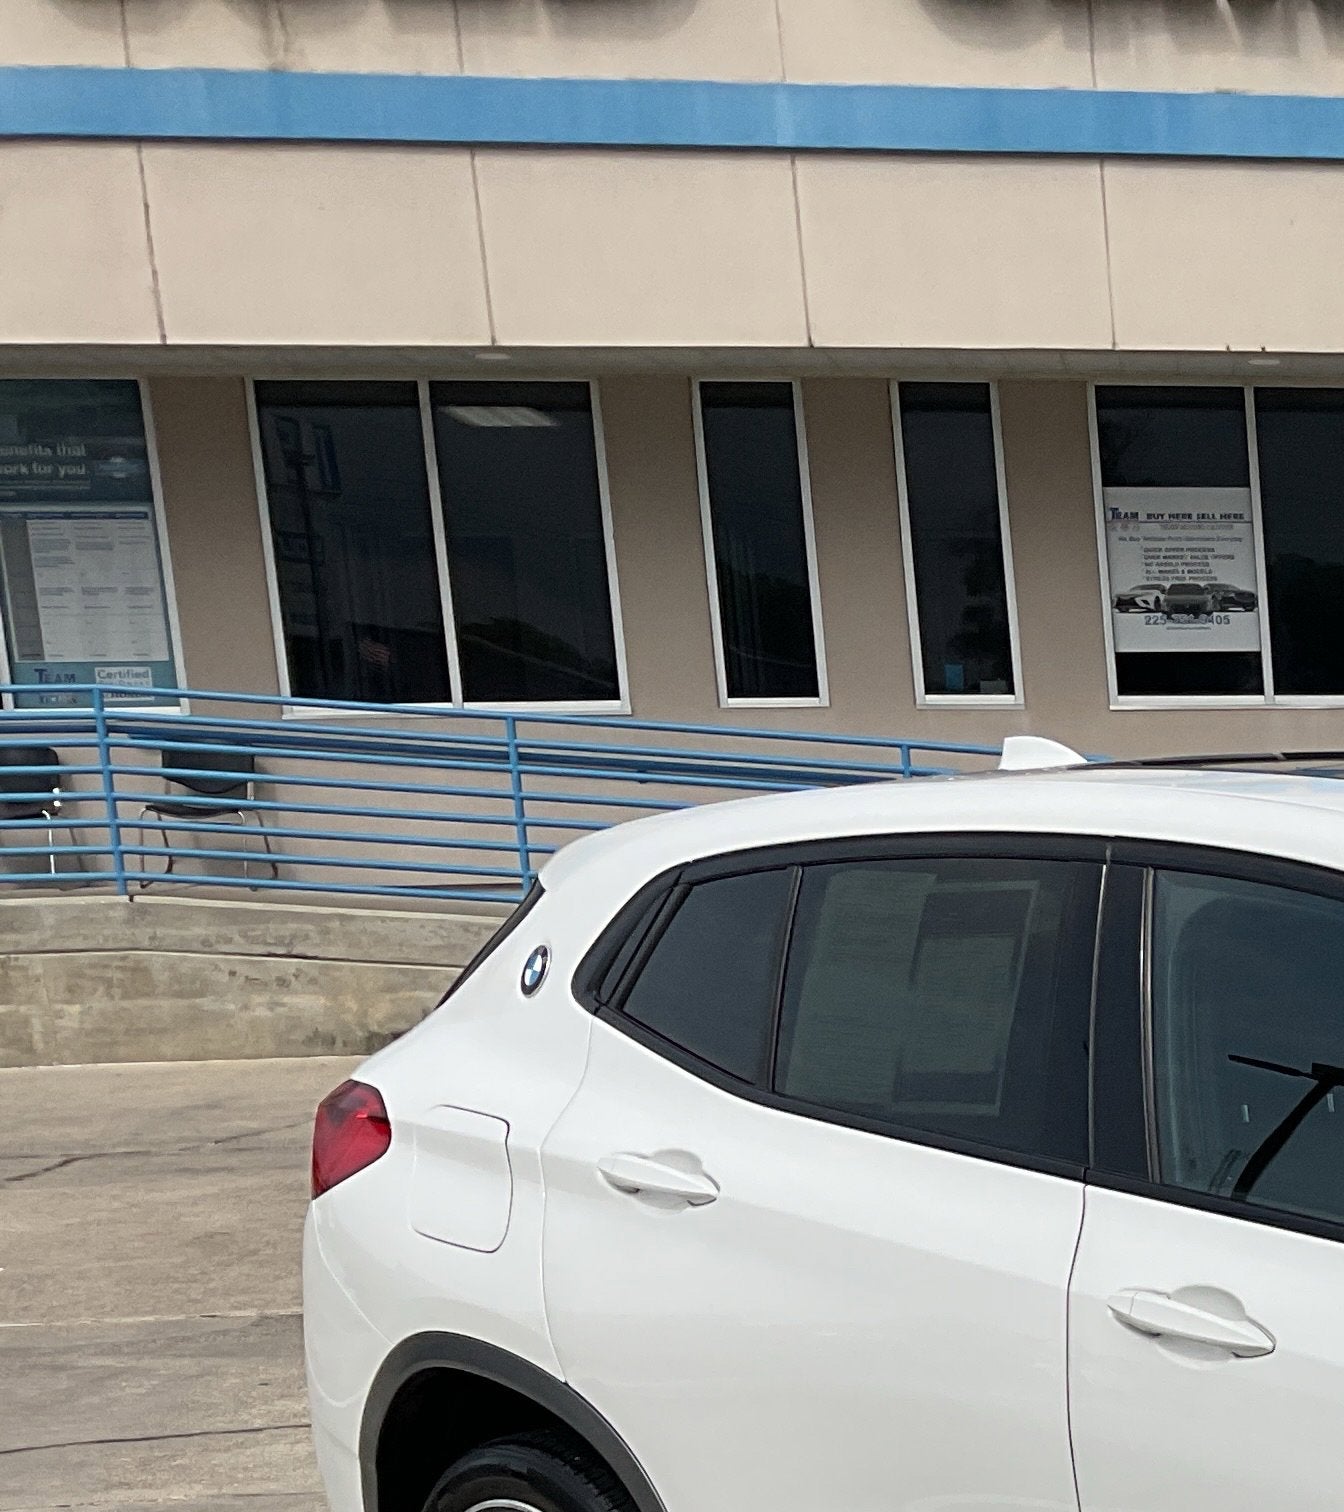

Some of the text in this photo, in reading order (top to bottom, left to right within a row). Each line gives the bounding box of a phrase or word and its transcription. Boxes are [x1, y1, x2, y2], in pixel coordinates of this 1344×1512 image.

[56, 442, 86, 456] that
[0, 460, 85, 478] ork for you
[34, 668, 76, 683] TEAM
[97, 669, 149, 682] Certified
